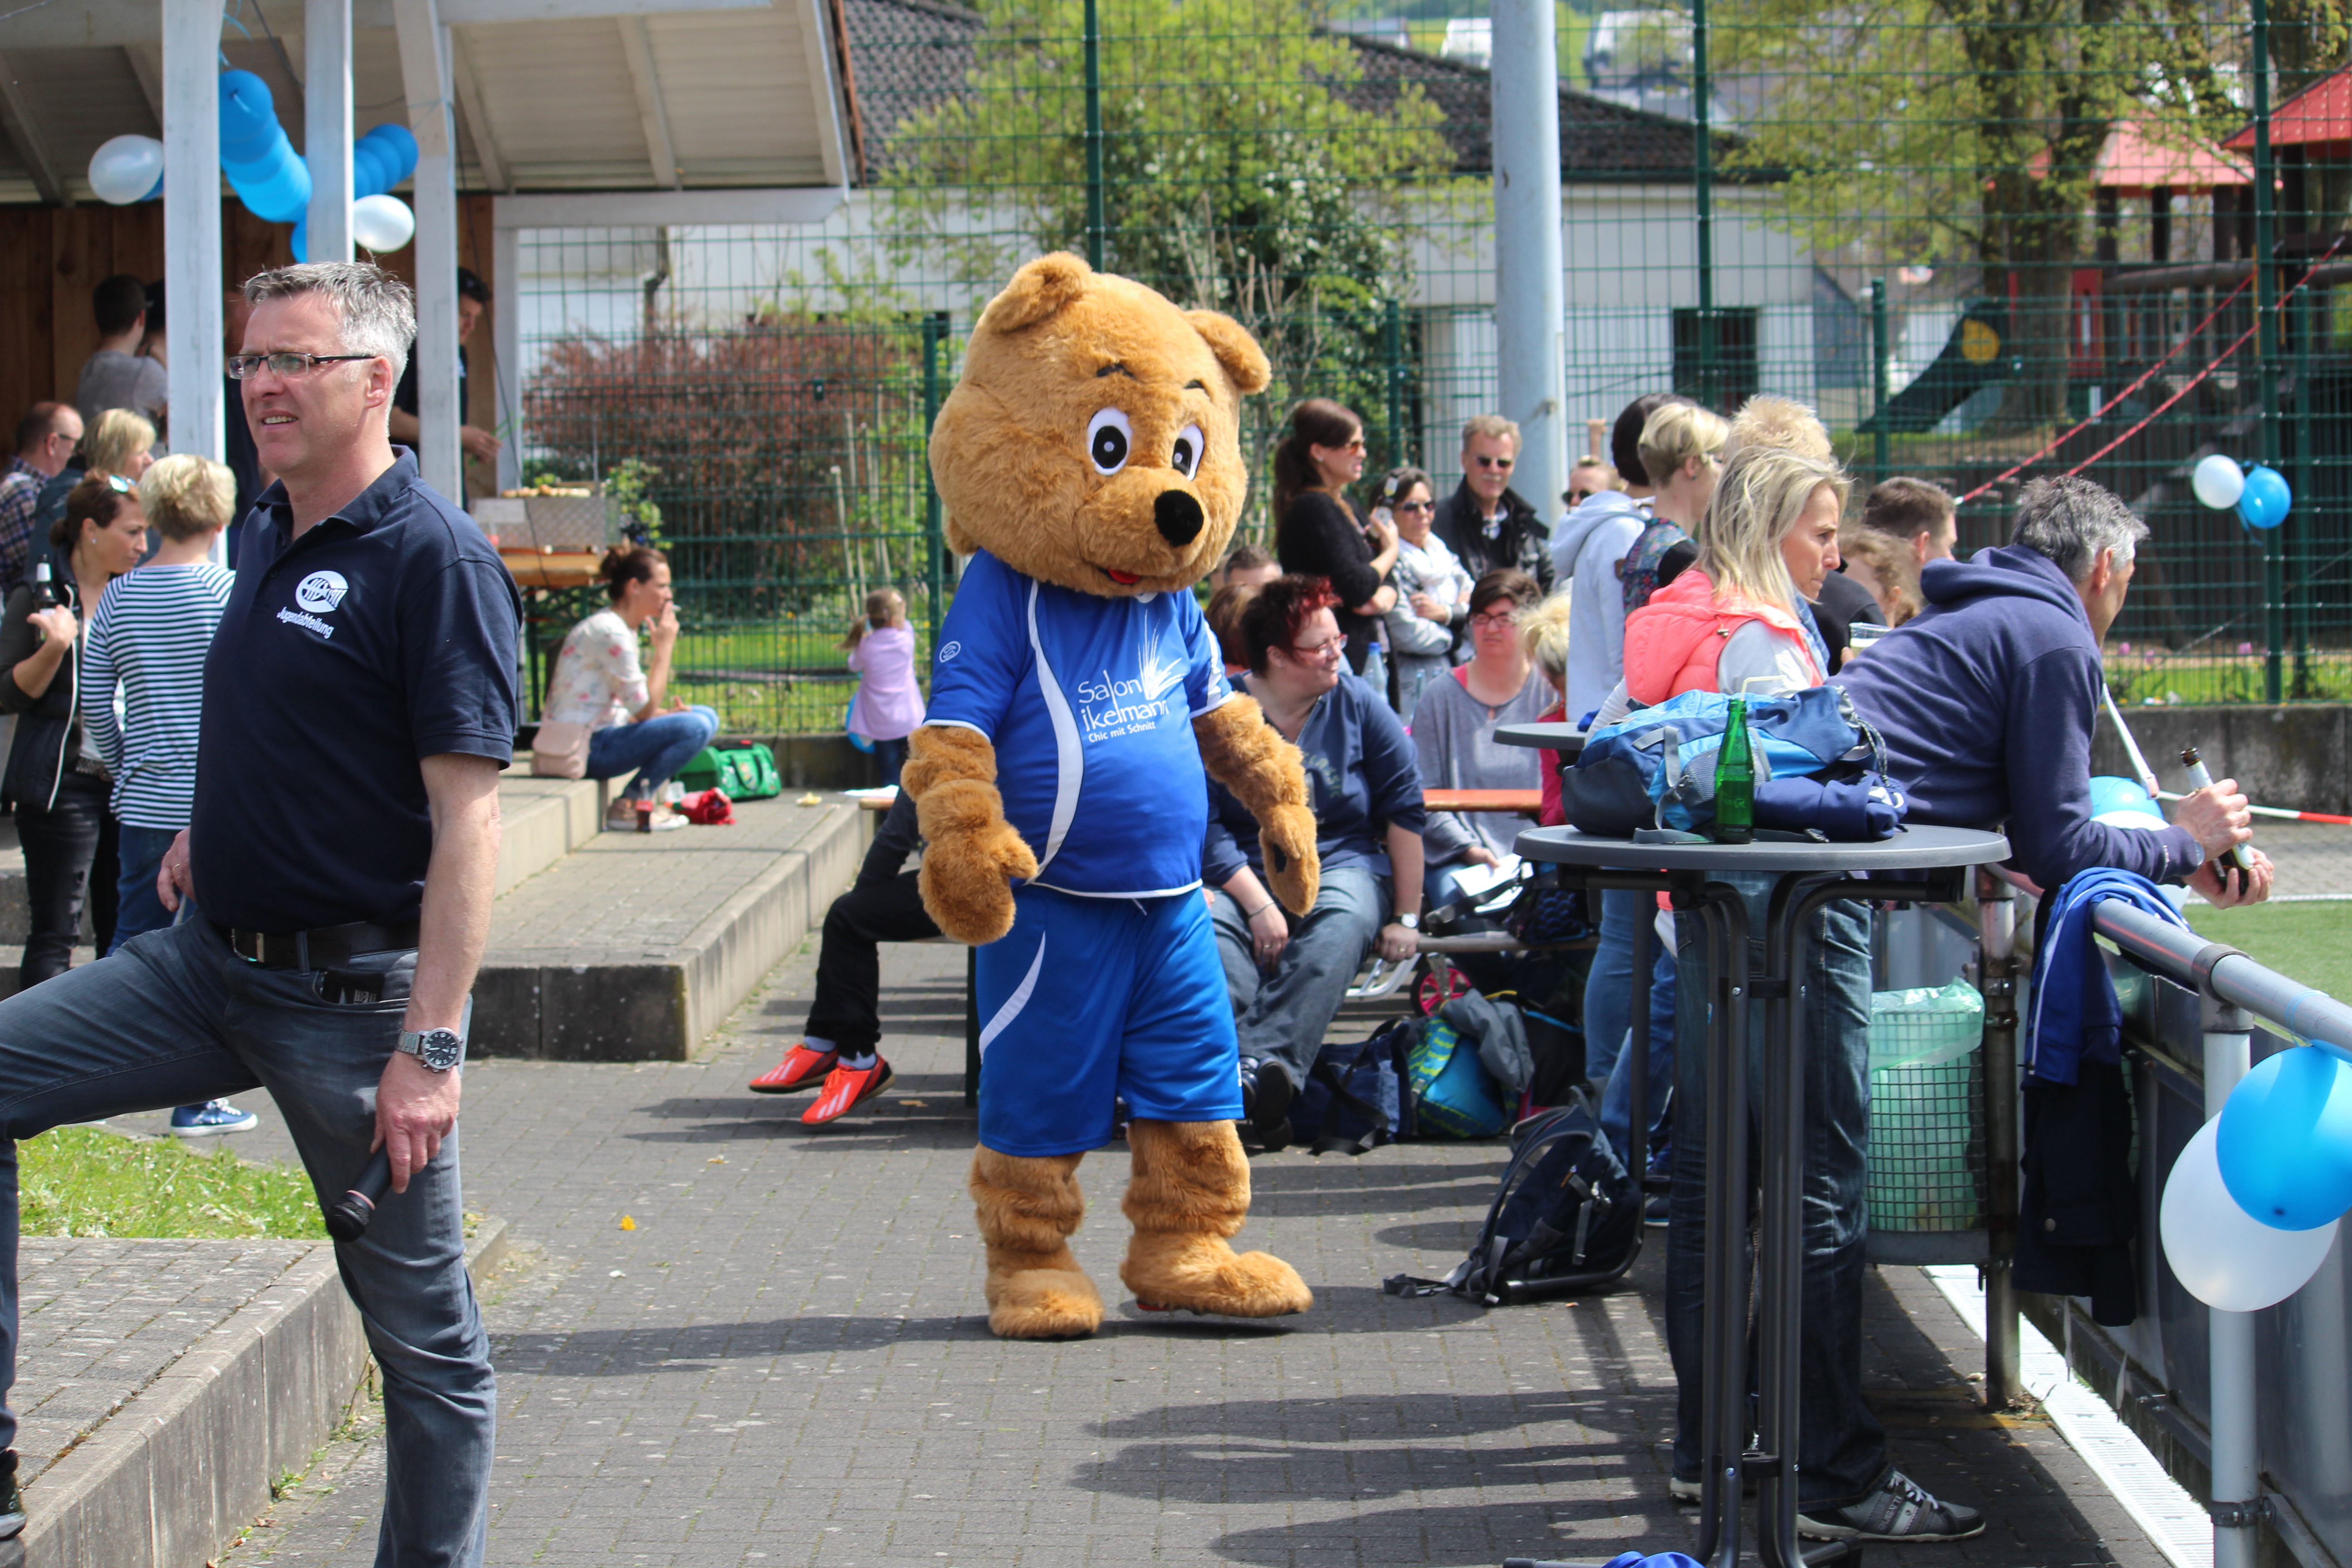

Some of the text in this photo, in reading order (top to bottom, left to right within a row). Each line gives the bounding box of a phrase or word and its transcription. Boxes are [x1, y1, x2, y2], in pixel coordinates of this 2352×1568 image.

[326, 588, 348, 608] 1977
[276, 606, 335, 639] Jugendabteilung
[1078, 670, 1142, 704] Salon
[1088, 721, 1156, 743] Chic mit Schnitt
